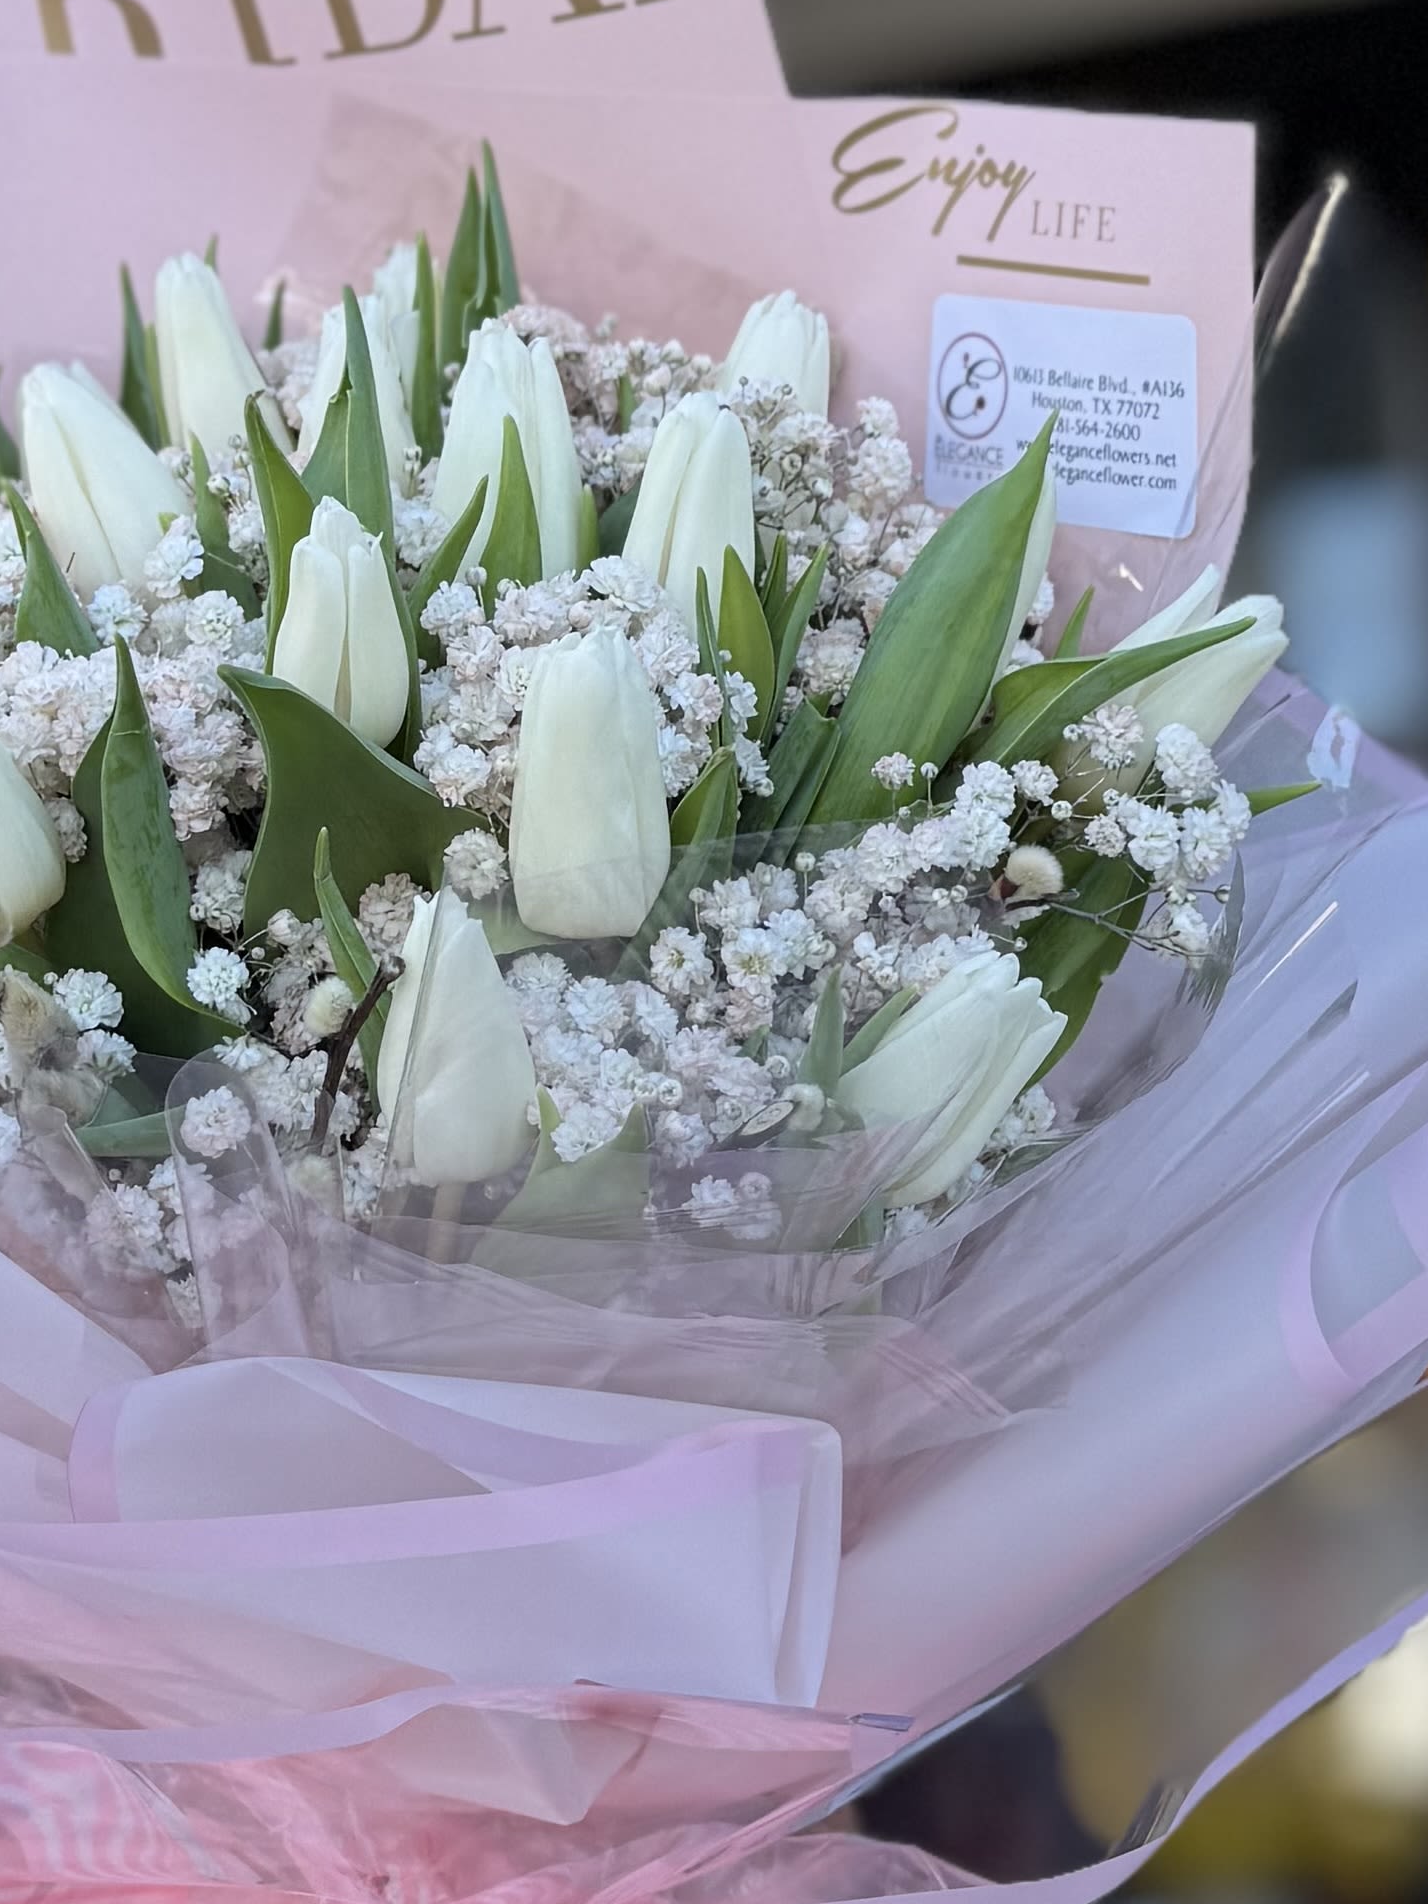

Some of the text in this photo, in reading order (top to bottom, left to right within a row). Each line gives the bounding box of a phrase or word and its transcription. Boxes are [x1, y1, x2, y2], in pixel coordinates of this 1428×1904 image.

[831, 102, 1116, 244] Enjoy LIFE
[1013, 365, 1044, 386] 10613
[1047, 369, 1094, 391] Bellaire
[1141, 379, 1185, 399] #A136
[1092, 397, 1112, 416] TX
[1116, 399, 1160, 420] 77072
[1055, 416, 1141, 441] 81-564-2600
